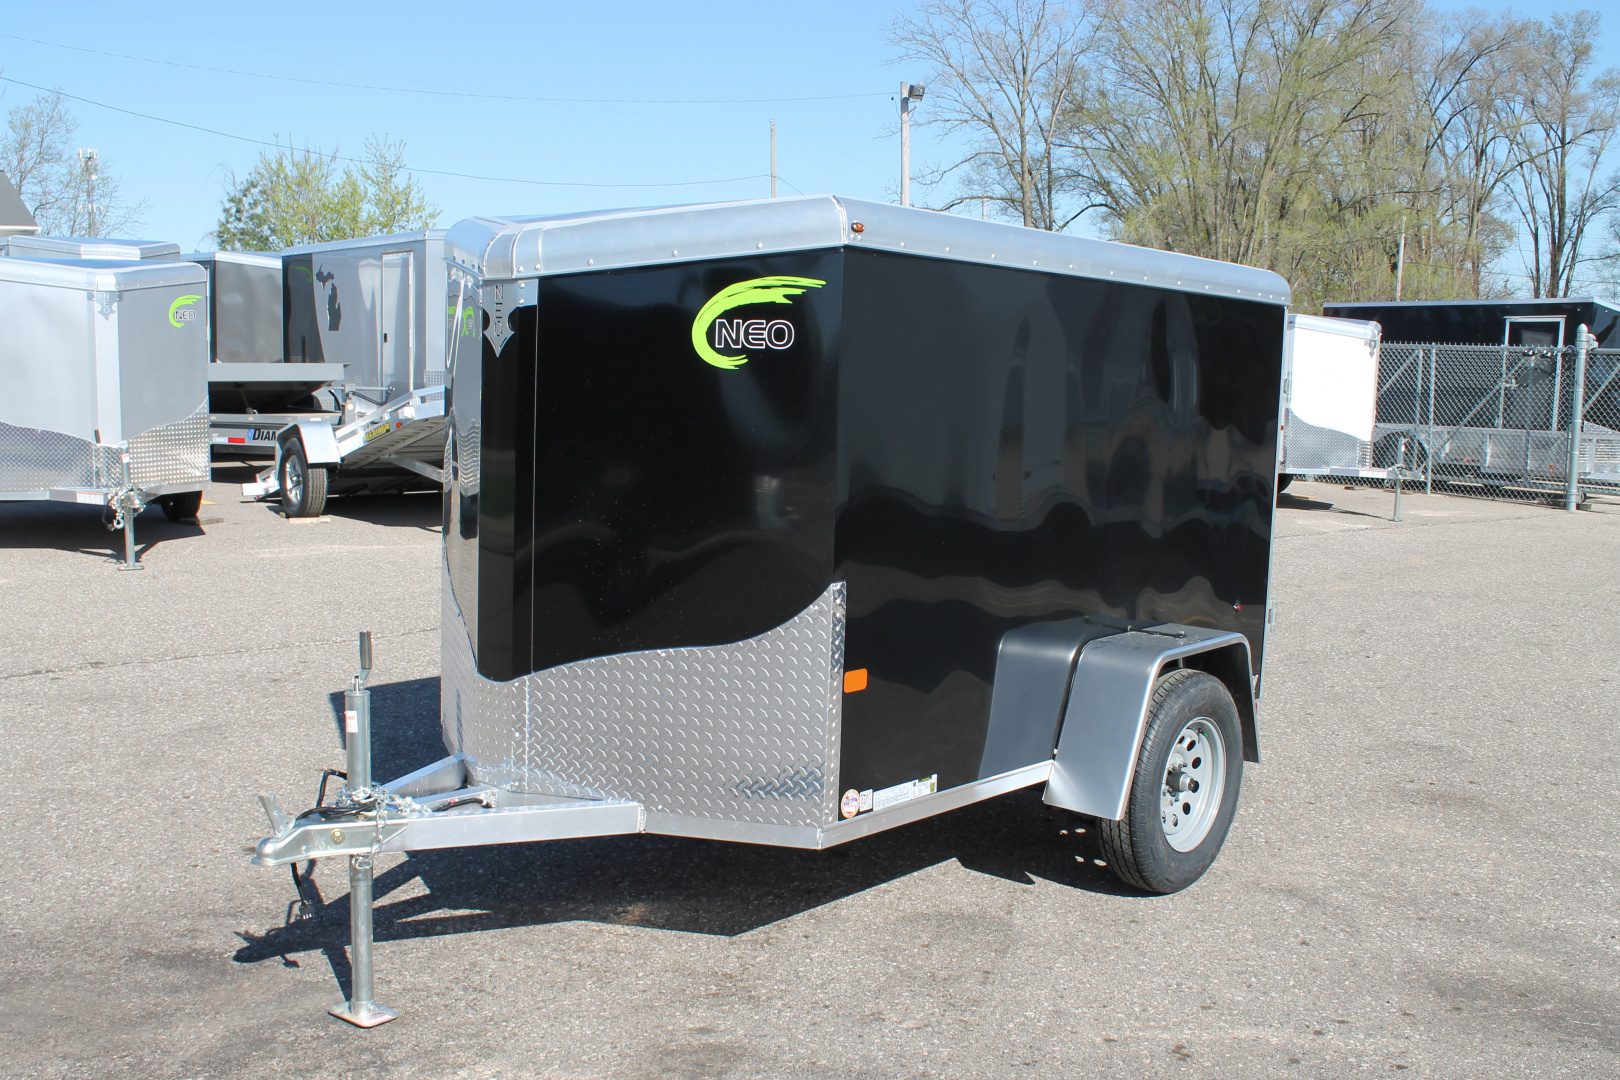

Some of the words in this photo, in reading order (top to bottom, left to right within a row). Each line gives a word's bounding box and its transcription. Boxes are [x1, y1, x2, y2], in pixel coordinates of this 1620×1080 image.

[174, 309, 197, 322] NEO
[493, 284, 504, 337] NEO
[715, 319, 795, 350] NEO
